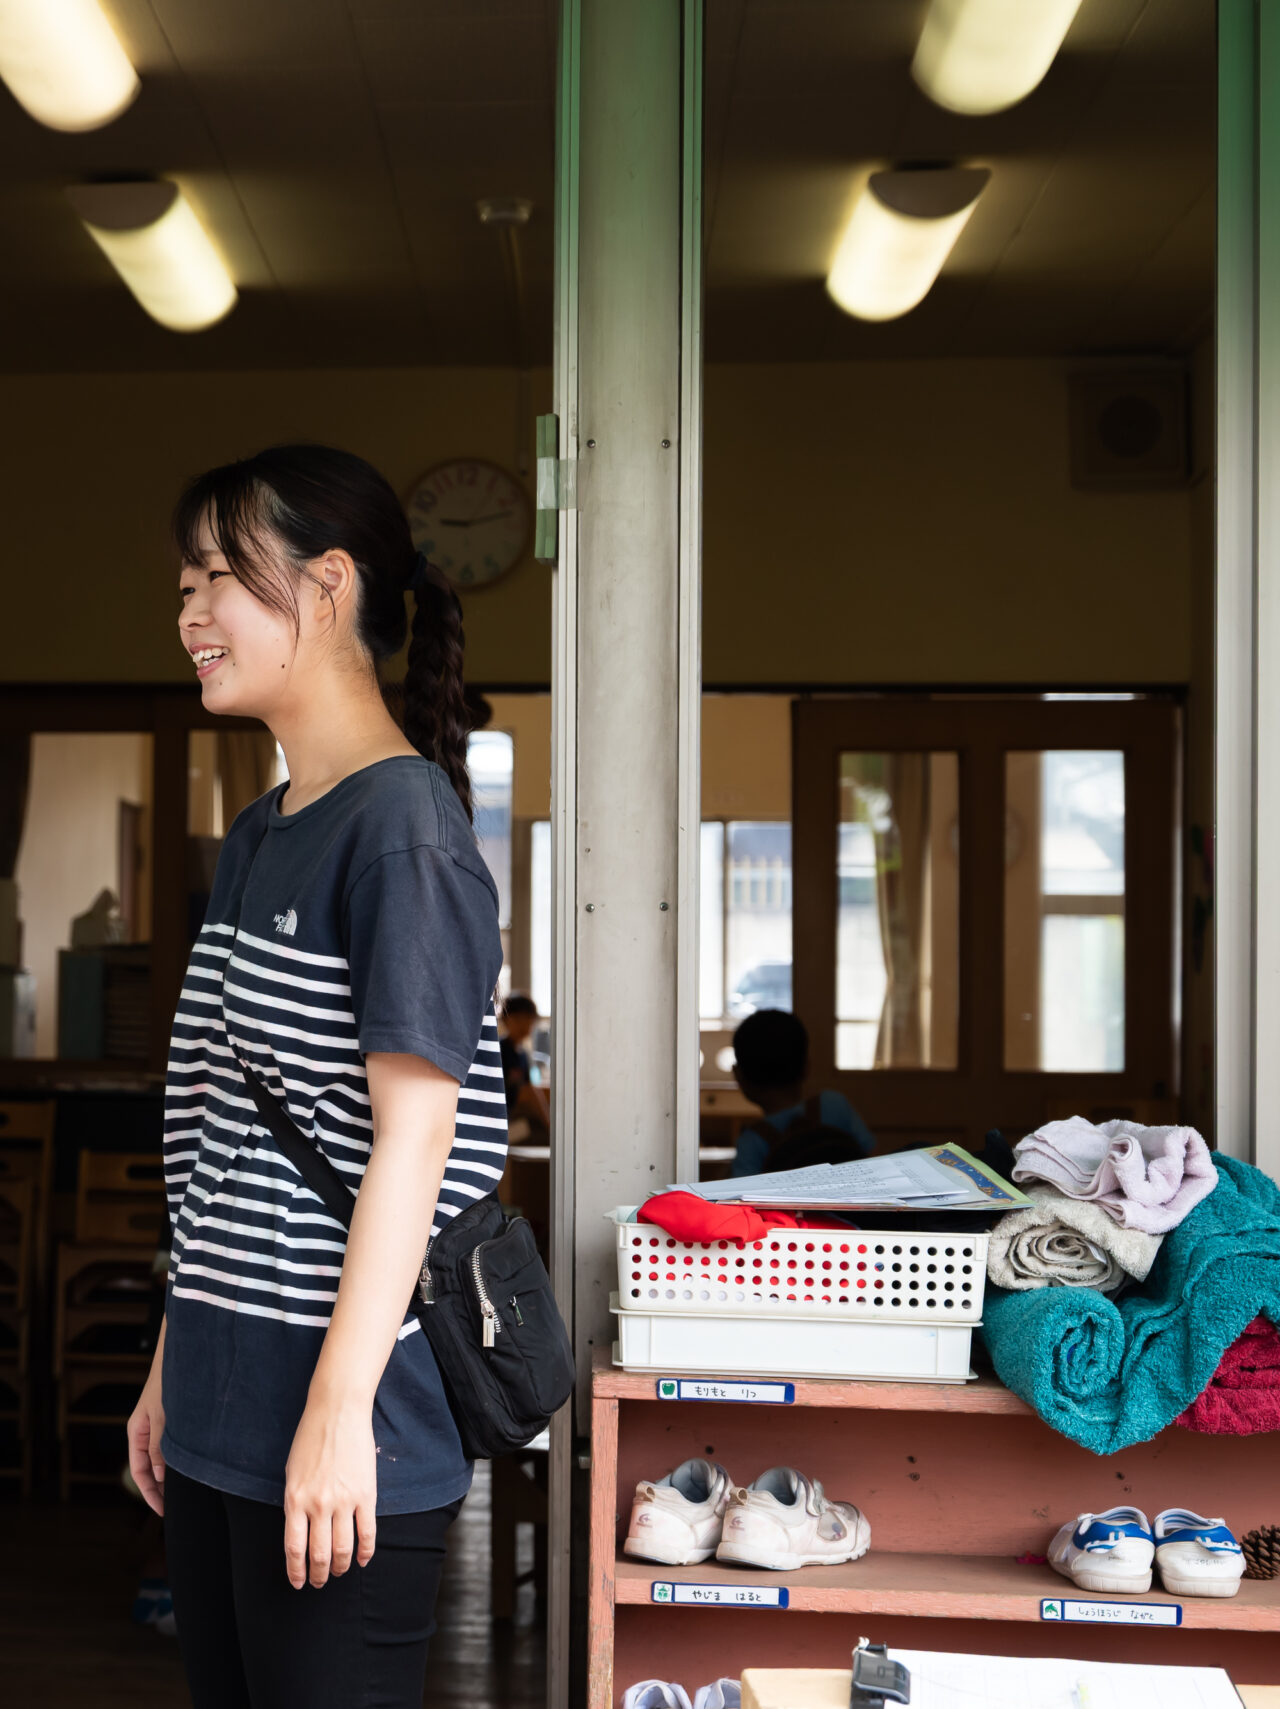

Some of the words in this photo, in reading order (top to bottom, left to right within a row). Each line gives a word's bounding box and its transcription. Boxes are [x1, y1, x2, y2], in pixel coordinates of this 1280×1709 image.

[694, 1385, 726, 1397] もりもと
[691, 1589, 721, 1601] やじま
[736, 1591, 762, 1602] はると
[1130, 1609, 1155, 1621] ながと
